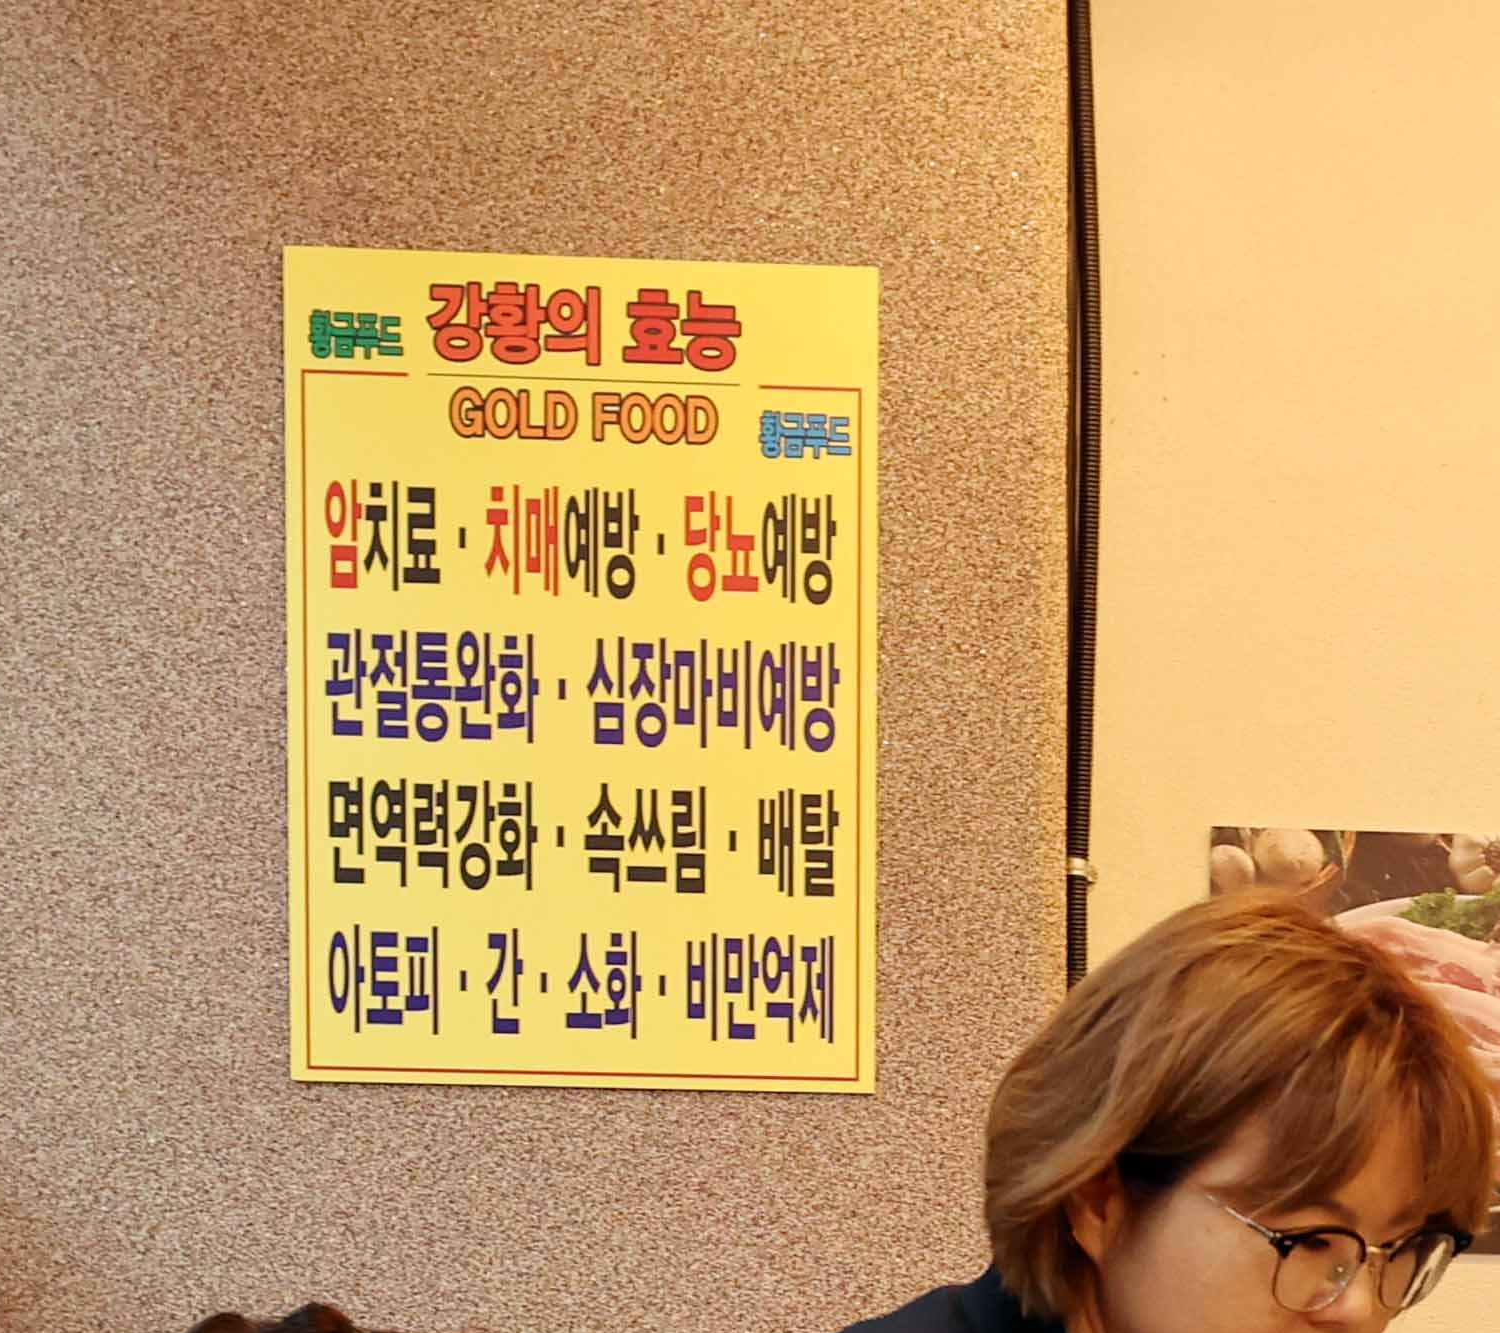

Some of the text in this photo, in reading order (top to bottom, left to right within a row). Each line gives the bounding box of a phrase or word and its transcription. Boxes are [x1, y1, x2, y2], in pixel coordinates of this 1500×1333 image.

[309, 309, 404, 360] 황금푸드
[426, 282, 742, 372] 강황의 효능
[449, 386, 718, 445] GOLD FOOD
[759, 410, 852, 460] 황금푸드
[324, 479, 837, 605] 암치료 치매예방 당뇨예방
[325, 629, 840, 752] 관절통완화 심장마비예방
[327, 777, 839, 897] 면역력강화 속쓰림 배탈
[328, 924, 835, 1043] 아토피 간 소화 비만억제
